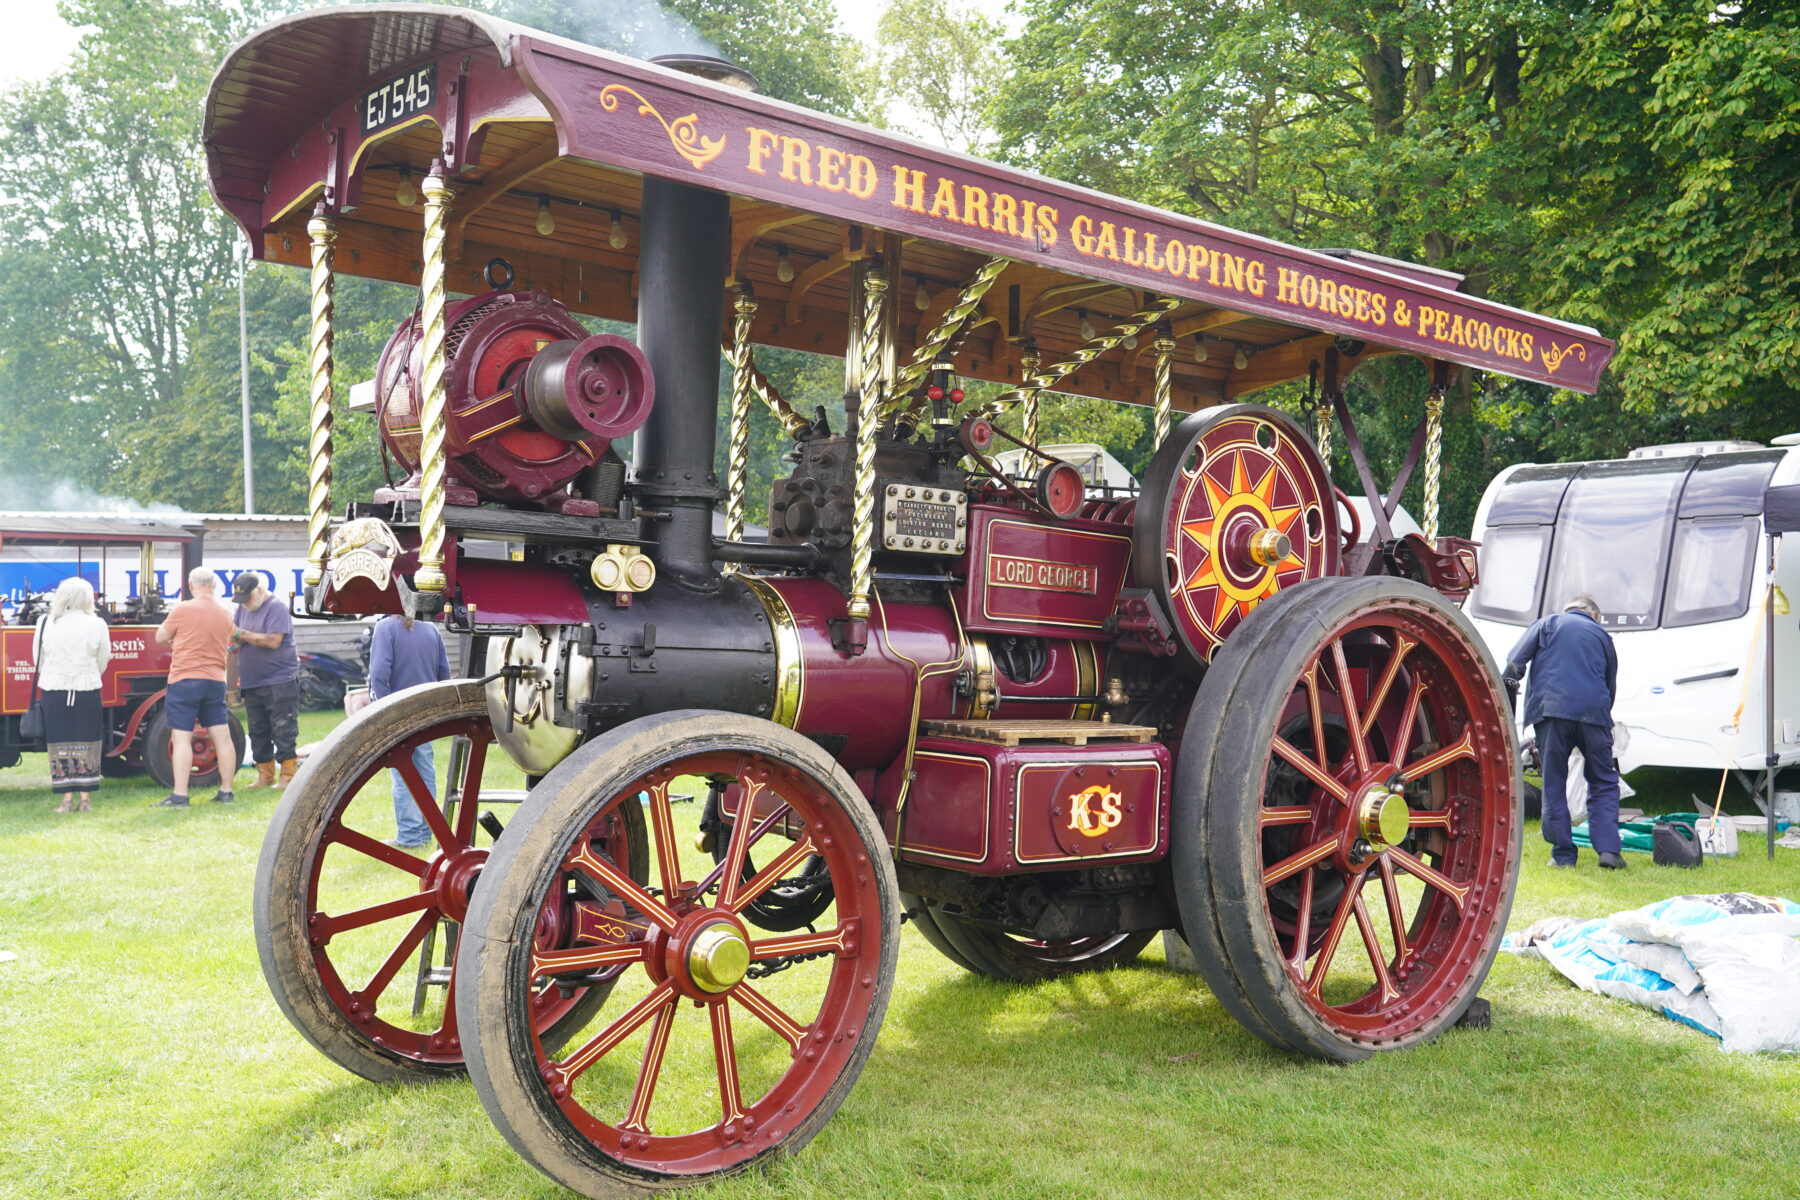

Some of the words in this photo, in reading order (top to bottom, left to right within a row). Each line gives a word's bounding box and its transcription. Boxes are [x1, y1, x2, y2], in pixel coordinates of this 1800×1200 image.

[367, 85, 391, 130] EJ
[392, 68, 430, 119] 545
[745, 127, 879, 200] FRED
[890, 164, 1058, 246] HARRIS
[1070, 214, 1267, 297] GALLOPING
[1276, 266, 1387, 326] HORSES
[1393, 299, 1412, 328] &
[1417, 305, 1534, 363] PEACOCKS
[338, 553, 384, 579] GARRETT
[996, 560, 1035, 584] LORD
[1038, 565, 1090, 591] GEORGE
[126, 569, 276, 599] LLYD
[1600, 615, 1648, 625] LEY
[110, 637, 146, 652] sen's
